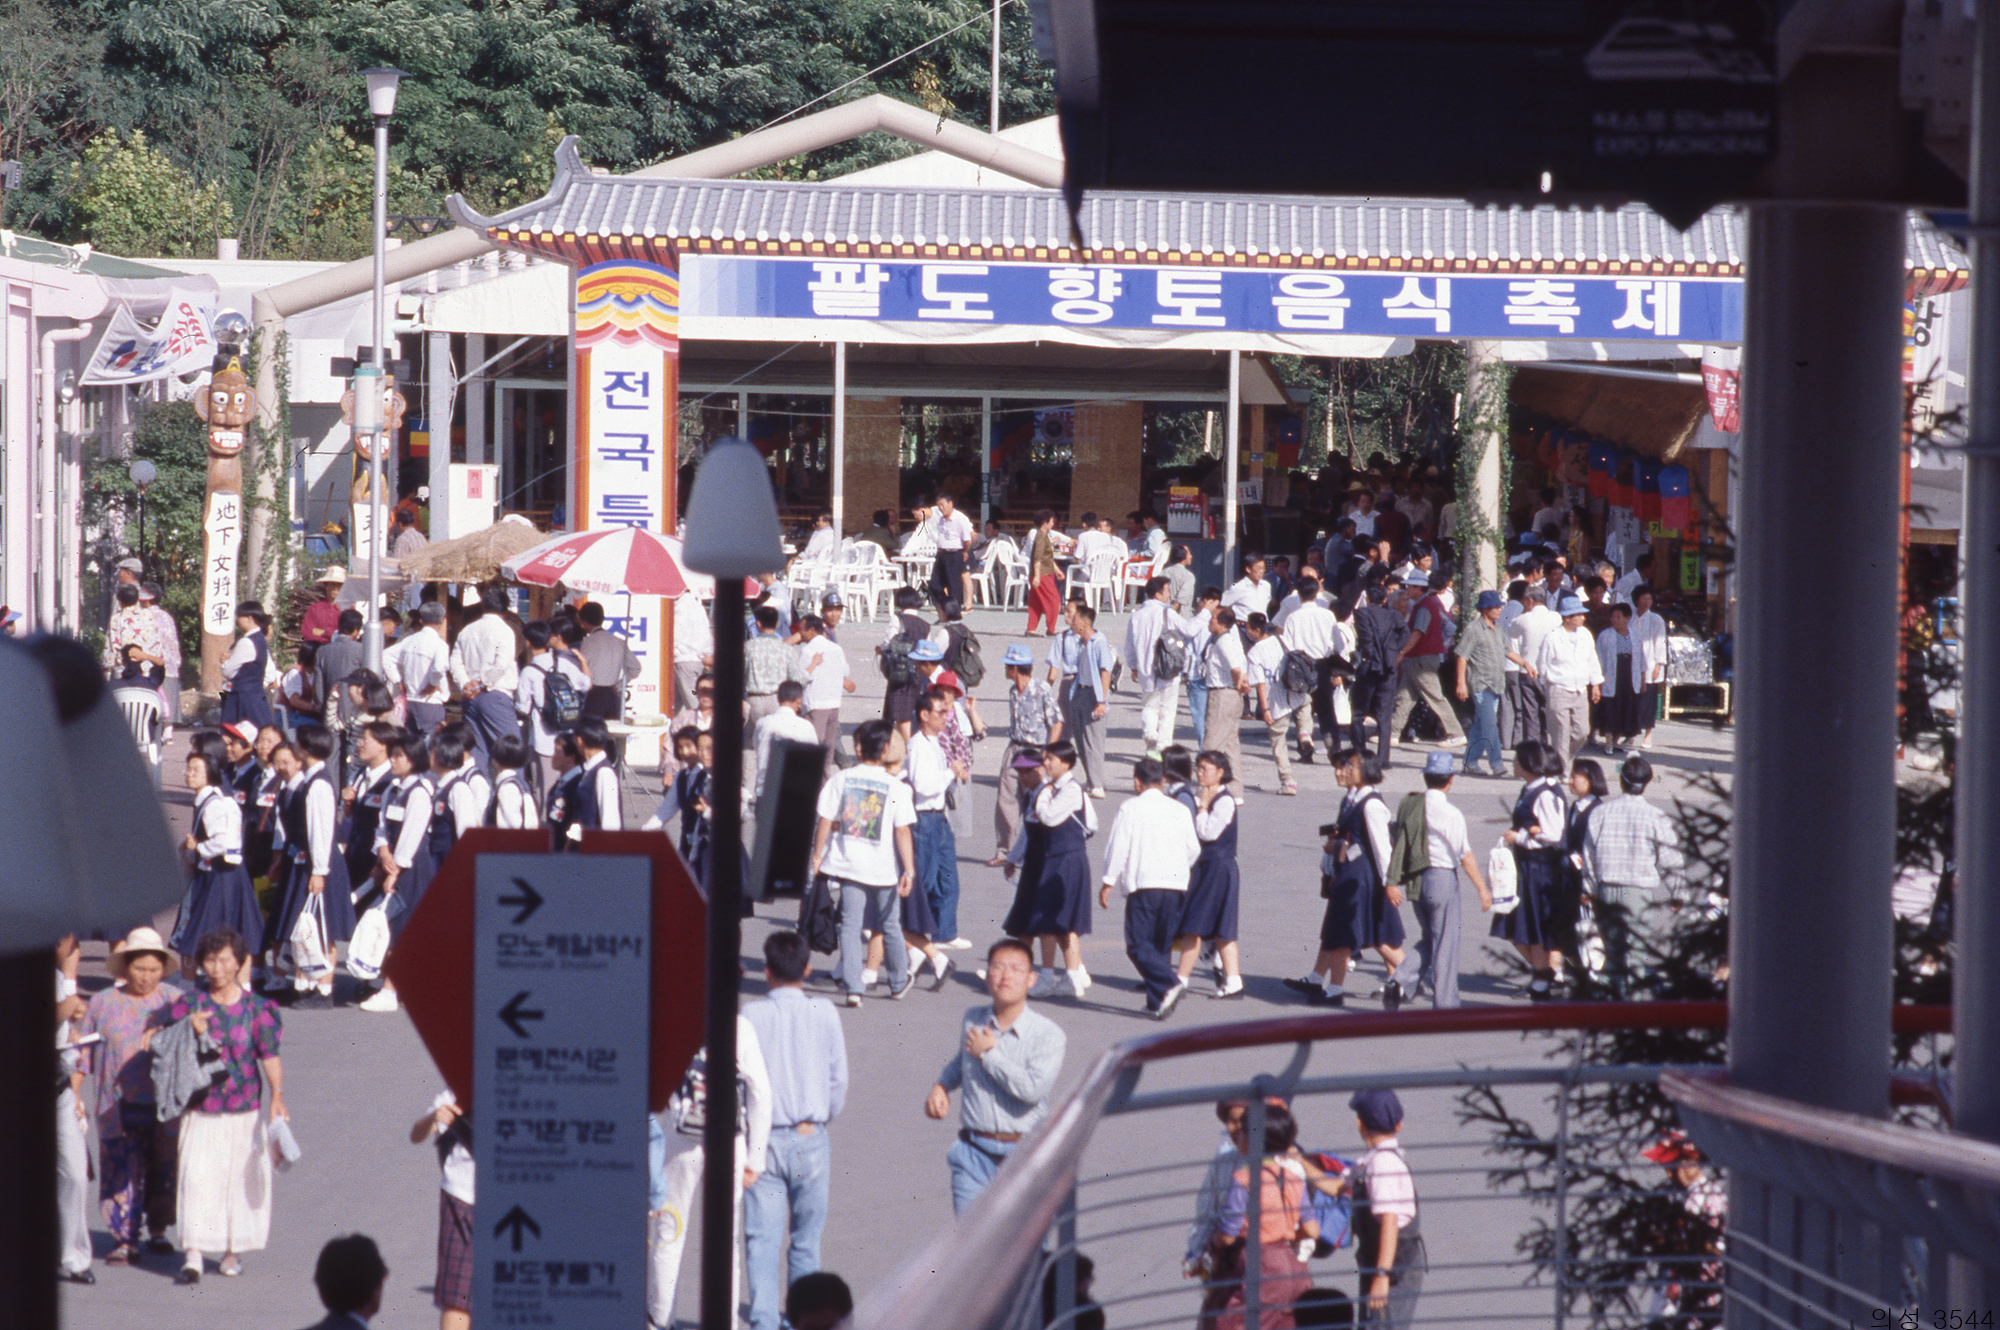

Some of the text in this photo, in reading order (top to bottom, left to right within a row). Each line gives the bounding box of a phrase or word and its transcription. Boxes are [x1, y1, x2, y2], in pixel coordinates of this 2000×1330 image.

[808, 262, 1681, 336] 팔도 향토 음식 축제
[597, 370, 656, 657] 전국특전
[211, 501, 238, 626] 地下女將軍
[496, 931, 643, 958] 모노레일역사
